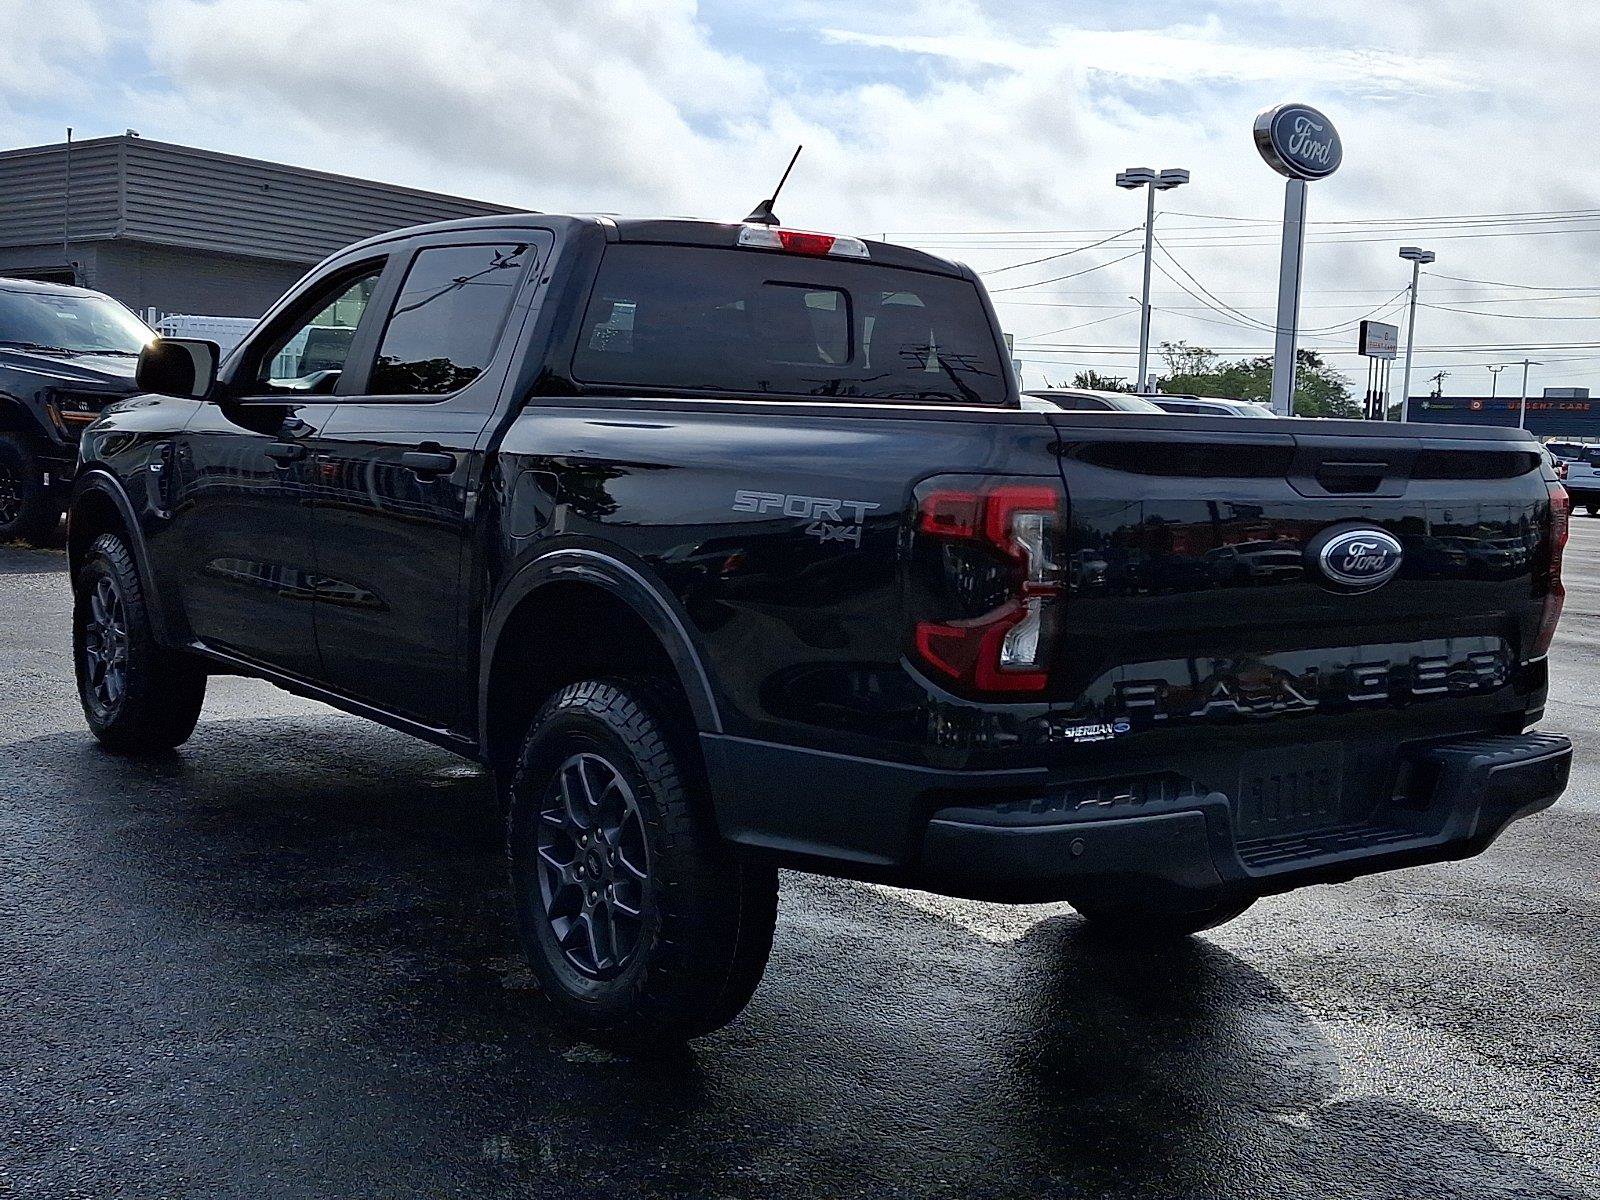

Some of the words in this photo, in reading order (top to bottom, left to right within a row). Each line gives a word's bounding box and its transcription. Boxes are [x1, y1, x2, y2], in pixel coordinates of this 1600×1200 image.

[1288, 116, 1333, 165] Ford
[1559, 402, 1591, 410] CARE
[732, 489, 881, 524] SPORT
[1343, 541, 1388, 571] Ford
[1064, 723, 1113, 737] SHERIDAN
